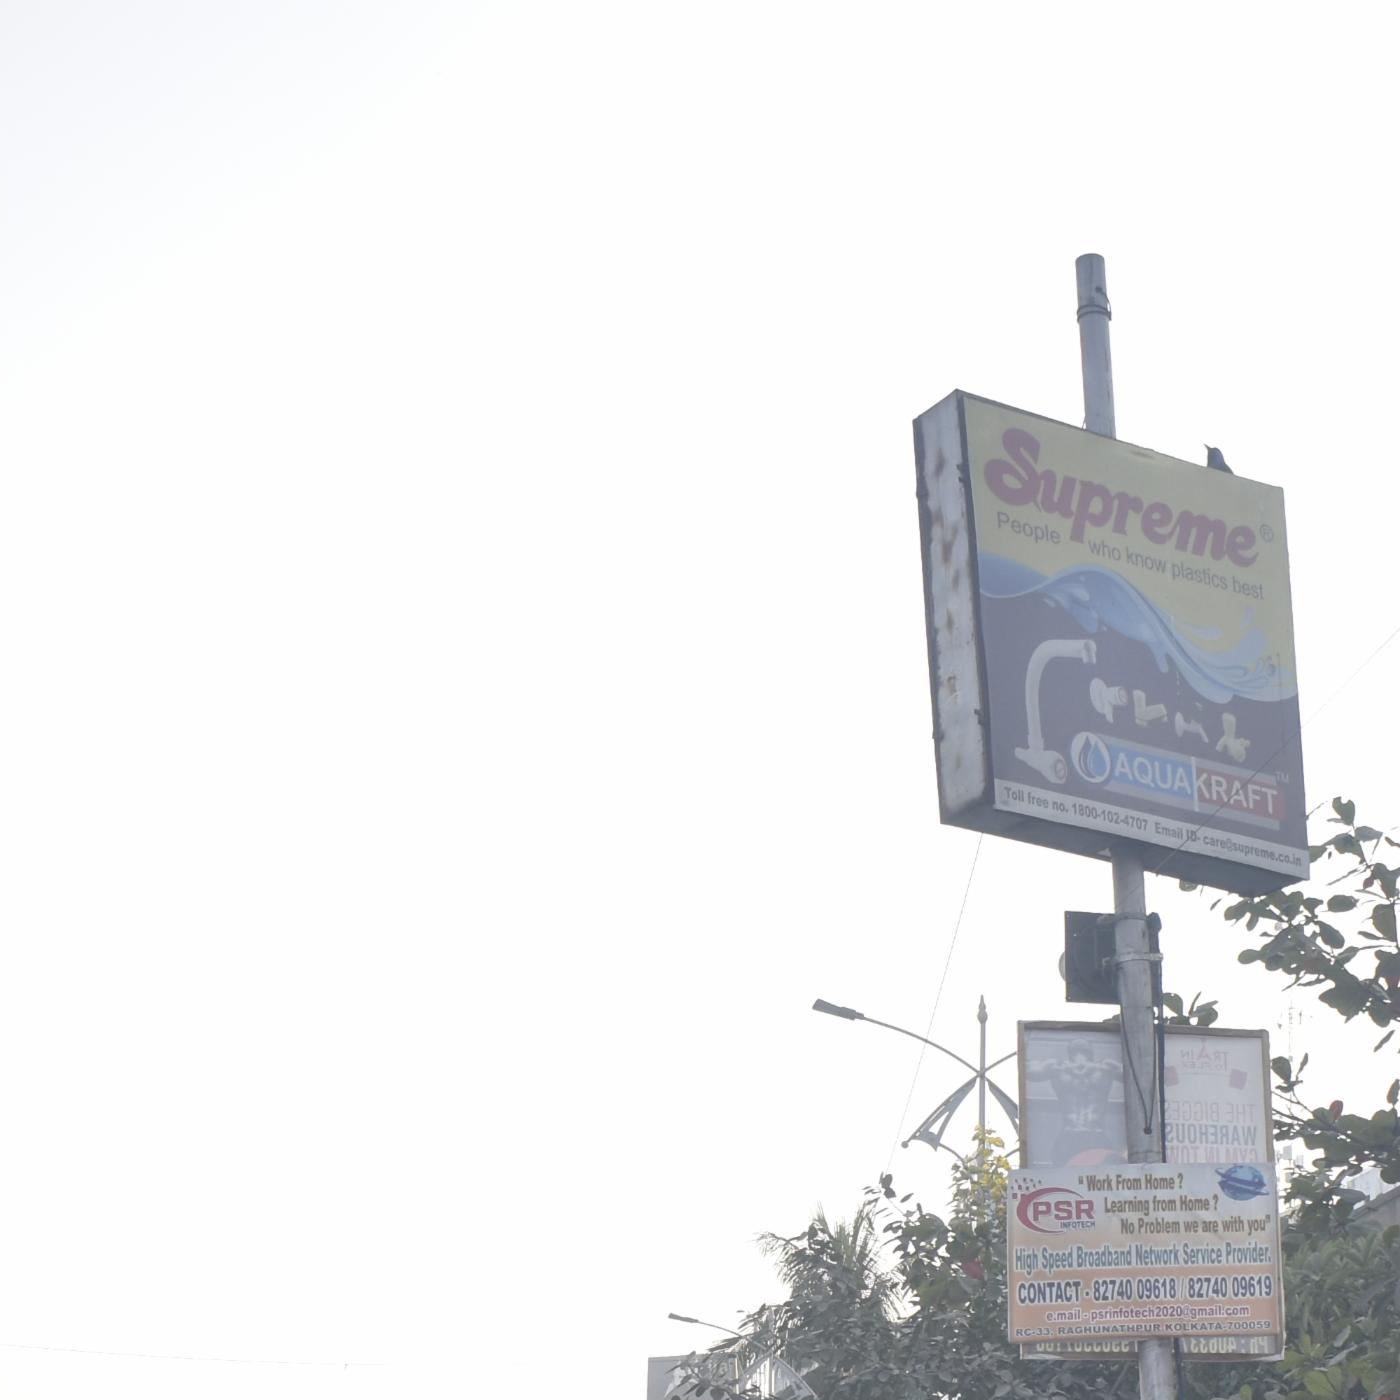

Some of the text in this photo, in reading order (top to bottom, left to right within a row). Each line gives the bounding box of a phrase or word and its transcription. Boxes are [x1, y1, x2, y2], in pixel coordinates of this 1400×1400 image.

[983, 427, 1260, 568] Supreme
[996, 511, 1265, 601] People who know plastics best
[1004, 786, 1025, 803] Toll
[1027, 792, 1050, 809] free
[1052, 799, 1070, 814] no.
[1071, 802, 1149, 832] 1800-102-4707
[1154, 822, 1184, 841] Email
[1116, 1174, 1141, 1191] From
[1144, 1173, 1176, 1191] Home
[1032, 1199, 1095, 1221] PSR
[1104, 1197, 1150, 1216] Learning
[1152, 1196, 1177, 1212] from
[1180, 1194, 1211, 1211] Home
[1060, 1220, 1096, 1230] INFOTECH
[1120, 1218, 1135, 1235] No
[1138, 1216, 1182, 1235] Problem
[1183, 1221, 1199, 1233] we
[1202, 1221, 1218, 1233] are
[1221, 1216, 1245, 1233] with
[1015, 1248, 1039, 1275] High
[1041, 1246, 1074, 1274] Speed
[1077, 1244, 1133, 1270] Broadband
[1135, 1243, 1180, 1267] Network
[1182, 1242, 1223, 1266] Service
[1018, 1280, 1082, 1304] CONTACT
[1092, 1280, 1133, 1301] 82740
[1136, 1278, 1177, 1300] 09618
[1187, 1277, 1228, 1299] 82740
[1231, 1275, 1273, 1298] 09619
[1090, 1305, 1250, 1323] psrinfotech2020@gmail.com
[1057, 1322, 1162, 1336] RAGHUNATHPUR
[1164, 1319, 1272, 1333] KOLKATA-700059
